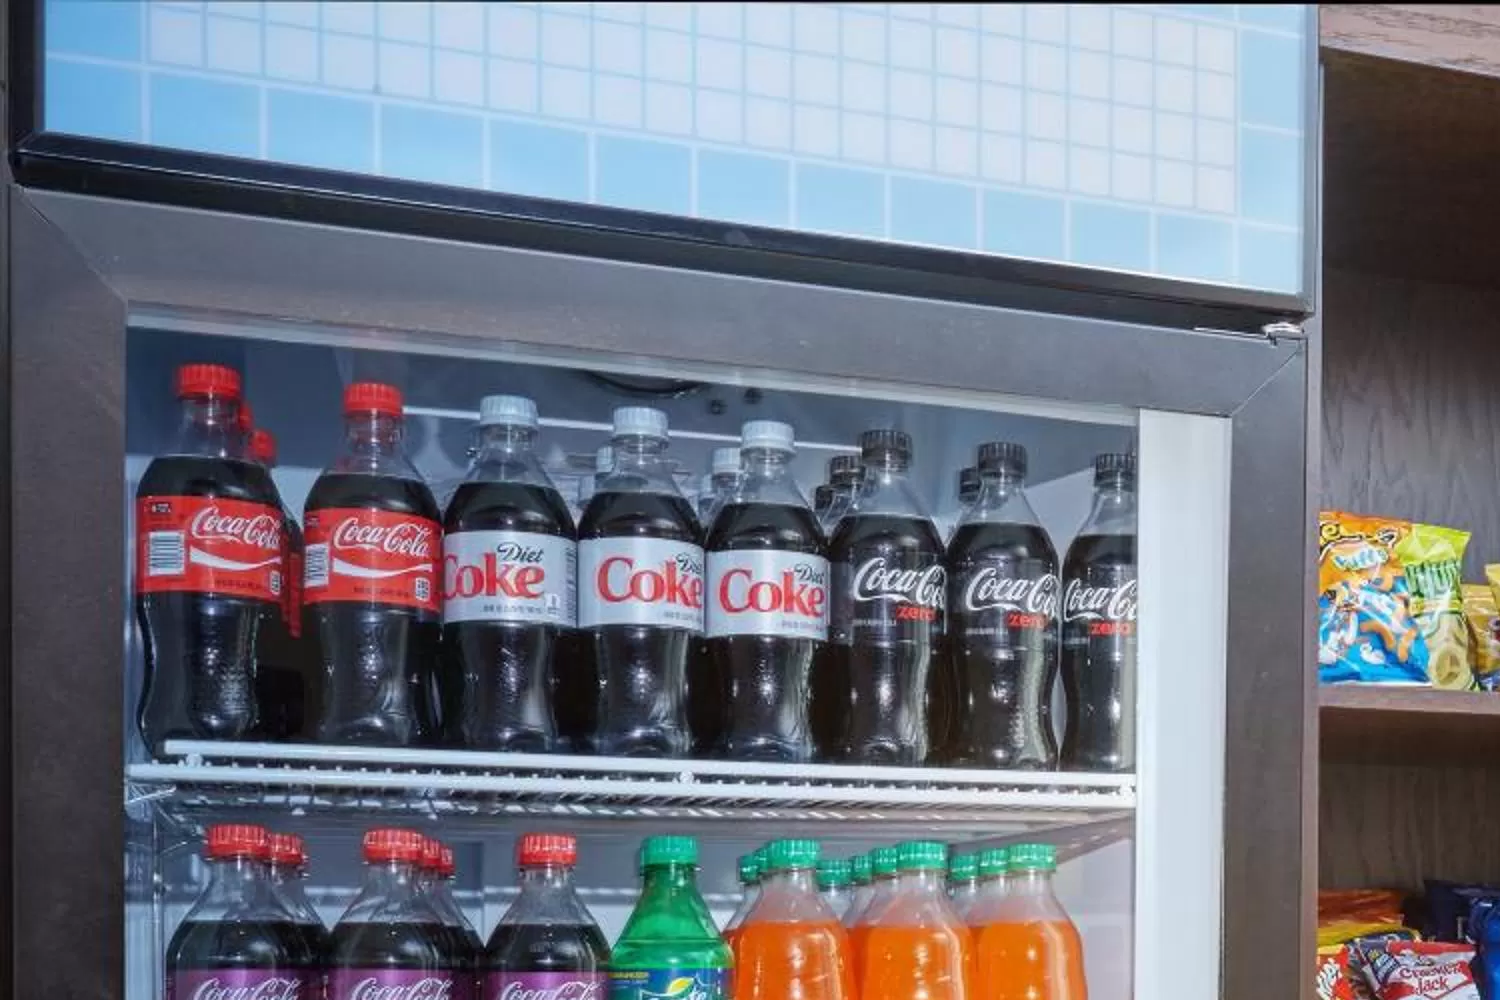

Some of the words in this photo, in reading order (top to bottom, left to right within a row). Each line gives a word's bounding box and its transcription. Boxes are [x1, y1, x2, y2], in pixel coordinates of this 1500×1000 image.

[333, 517, 431, 557] Coca-Cola
[497, 543, 544, 563] Diet
[444, 552, 544, 598] Coke
[719, 568, 826, 618] Coke
